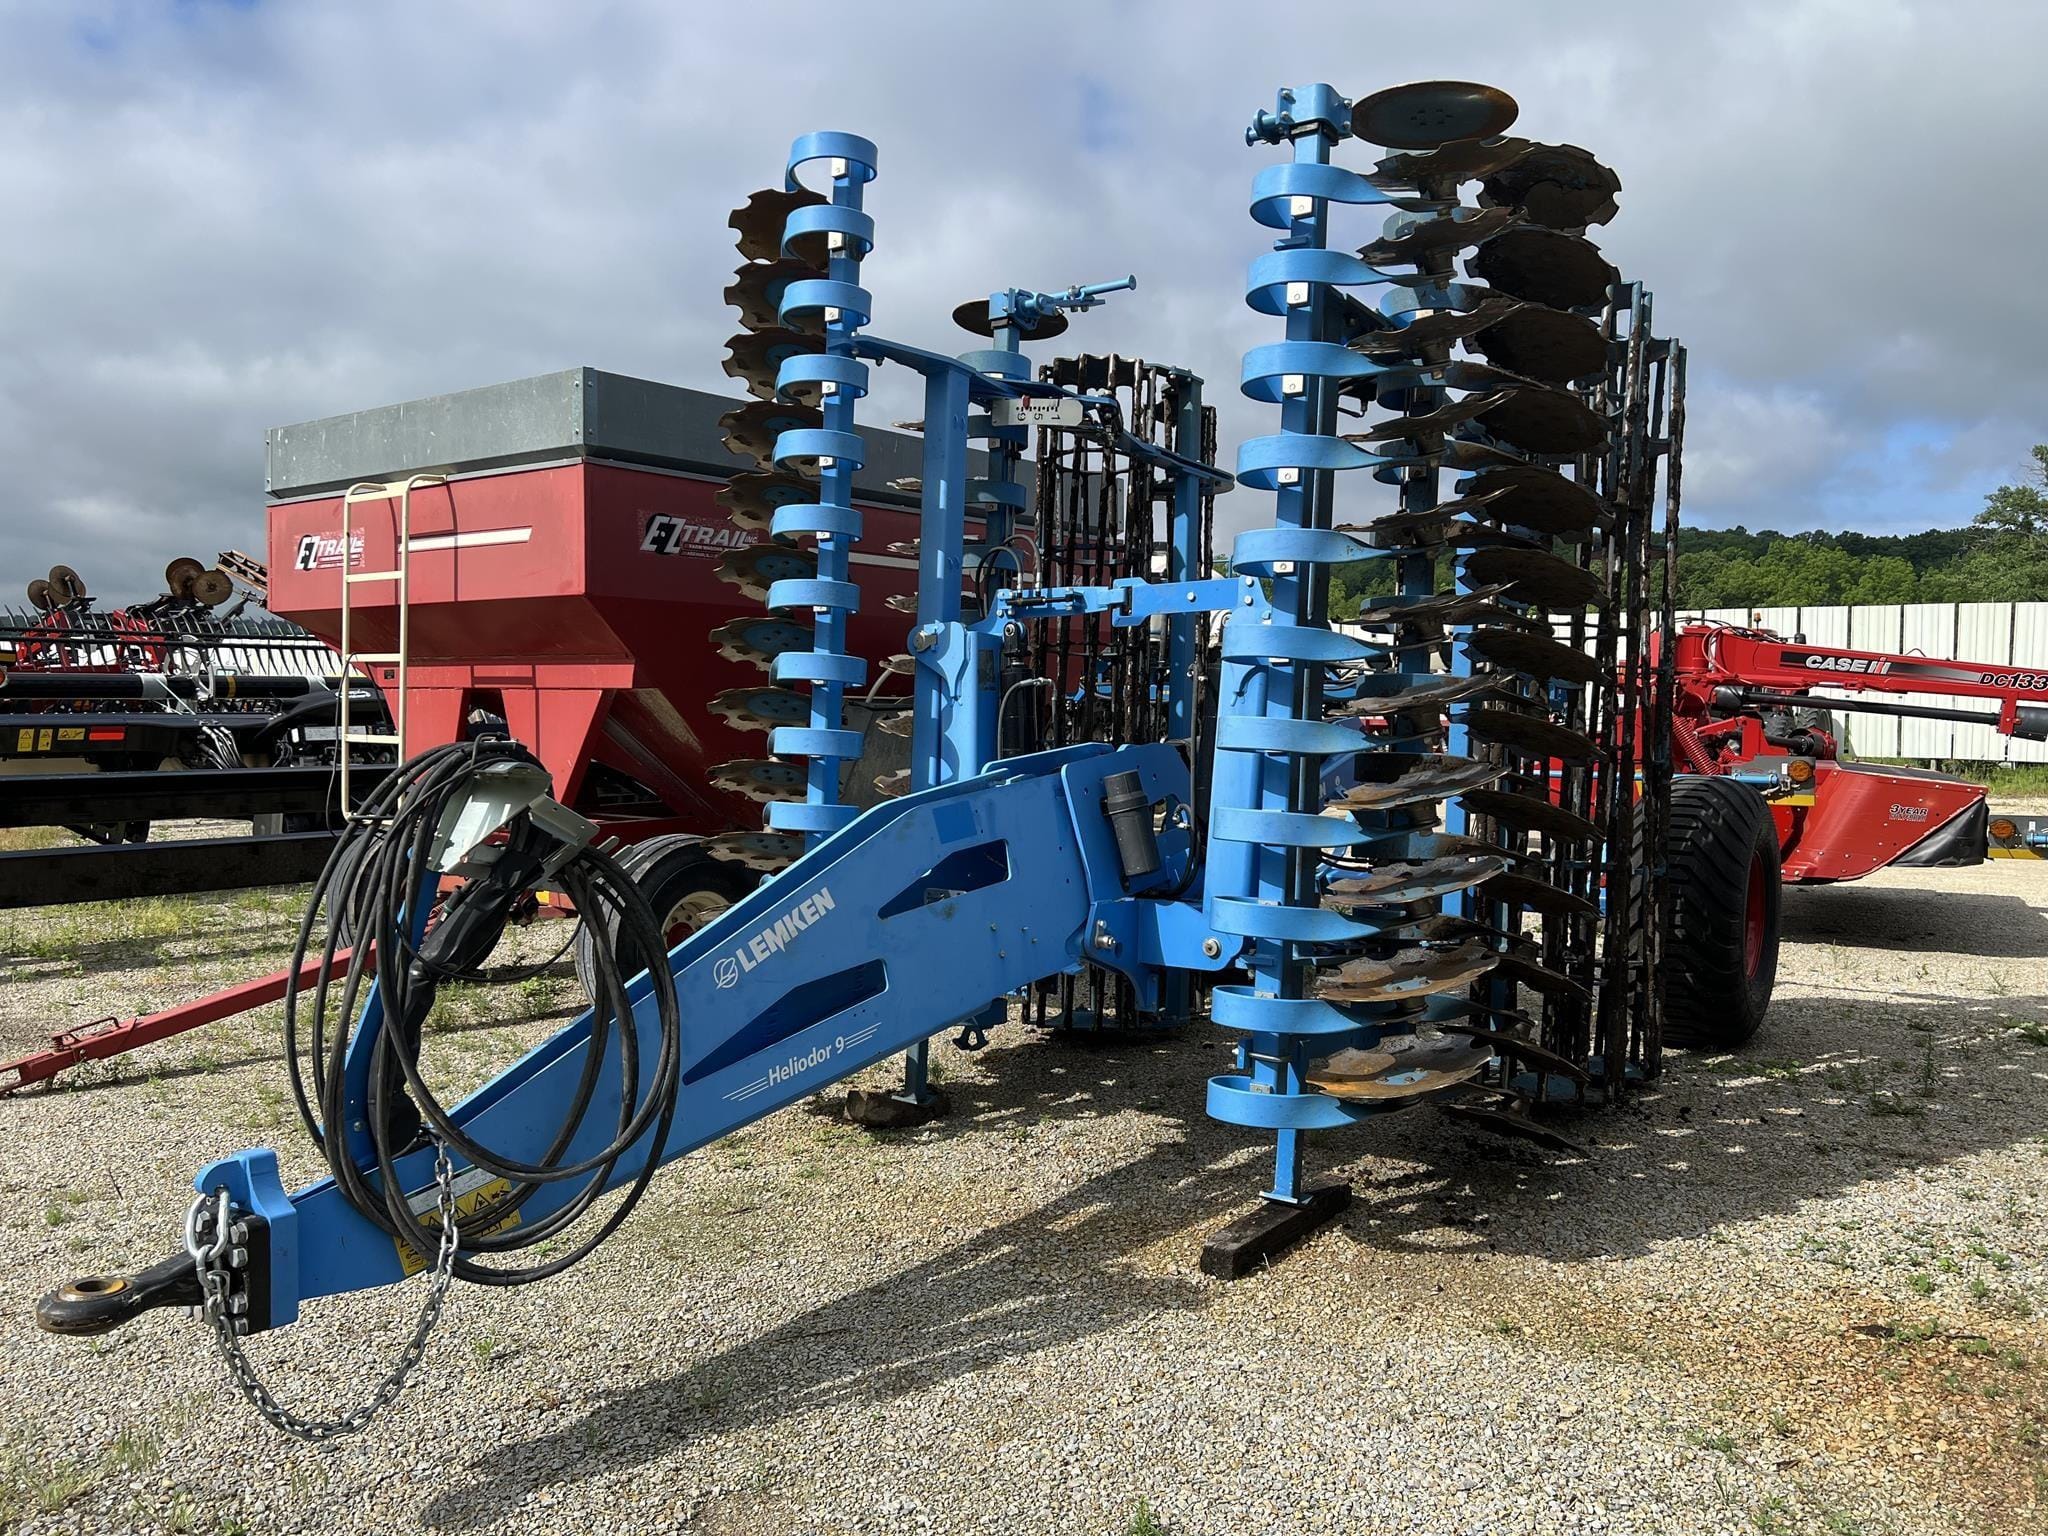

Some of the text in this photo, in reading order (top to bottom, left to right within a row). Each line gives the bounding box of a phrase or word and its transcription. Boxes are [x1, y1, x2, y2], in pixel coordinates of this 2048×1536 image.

[1034, 413, 1043, 421] 5
[682, 524, 749, 548] TRAIL
[318, 537, 363, 556] TRAL
[1805, 655, 1869, 673] CASE
[1979, 672, 2048, 692] DC133
[735, 886, 836, 973] LEMKEN
[768, 1036, 845, 1087] Heliodor 9
